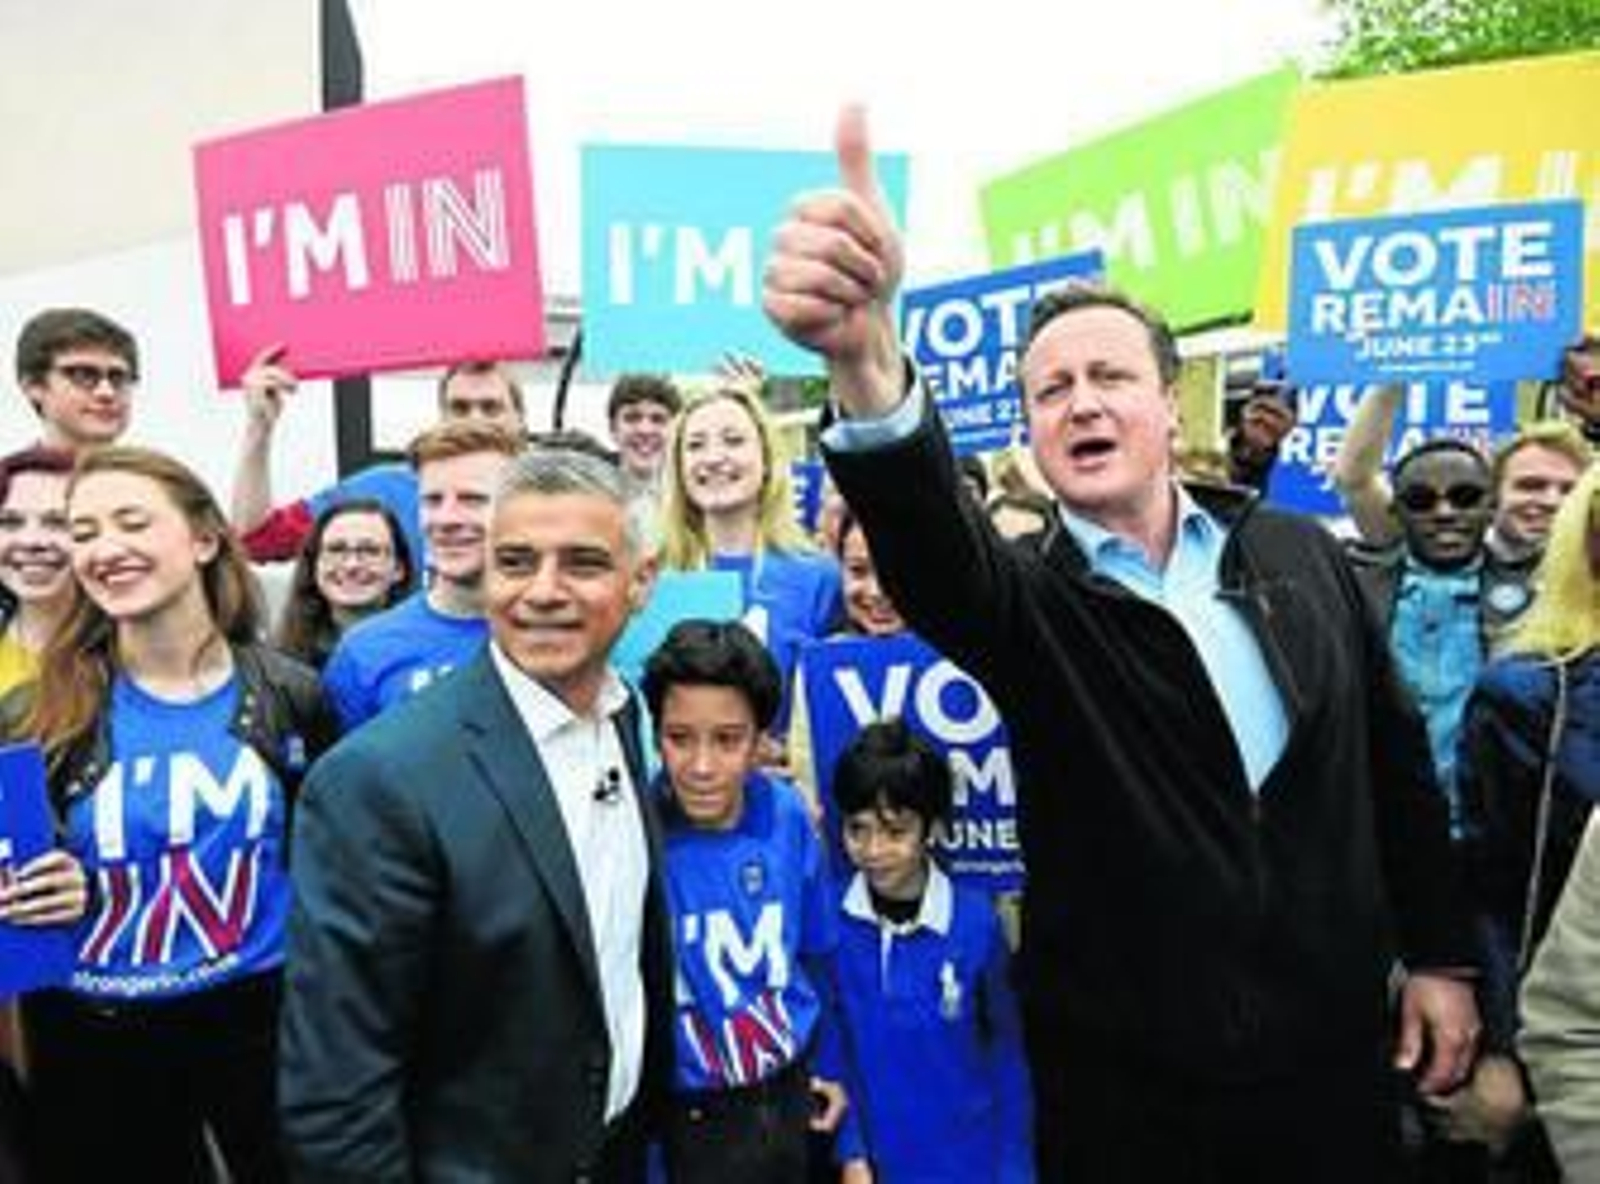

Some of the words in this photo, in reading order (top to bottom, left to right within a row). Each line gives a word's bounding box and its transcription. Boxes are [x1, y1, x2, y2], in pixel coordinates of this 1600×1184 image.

[223, 192, 371, 305] I'M
[384, 168, 511, 284] IN
[608, 224, 752, 305] I'M
[1314, 221, 1554, 291] VOTE
[1311, 279, 1556, 335] REMAIN
[1346, 331, 1433, 362] JUNE
[833, 660, 1000, 744] VO
[93, 747, 269, 860] I'M
[78, 841, 263, 967] IN
[676, 899, 788, 1009] 'M
